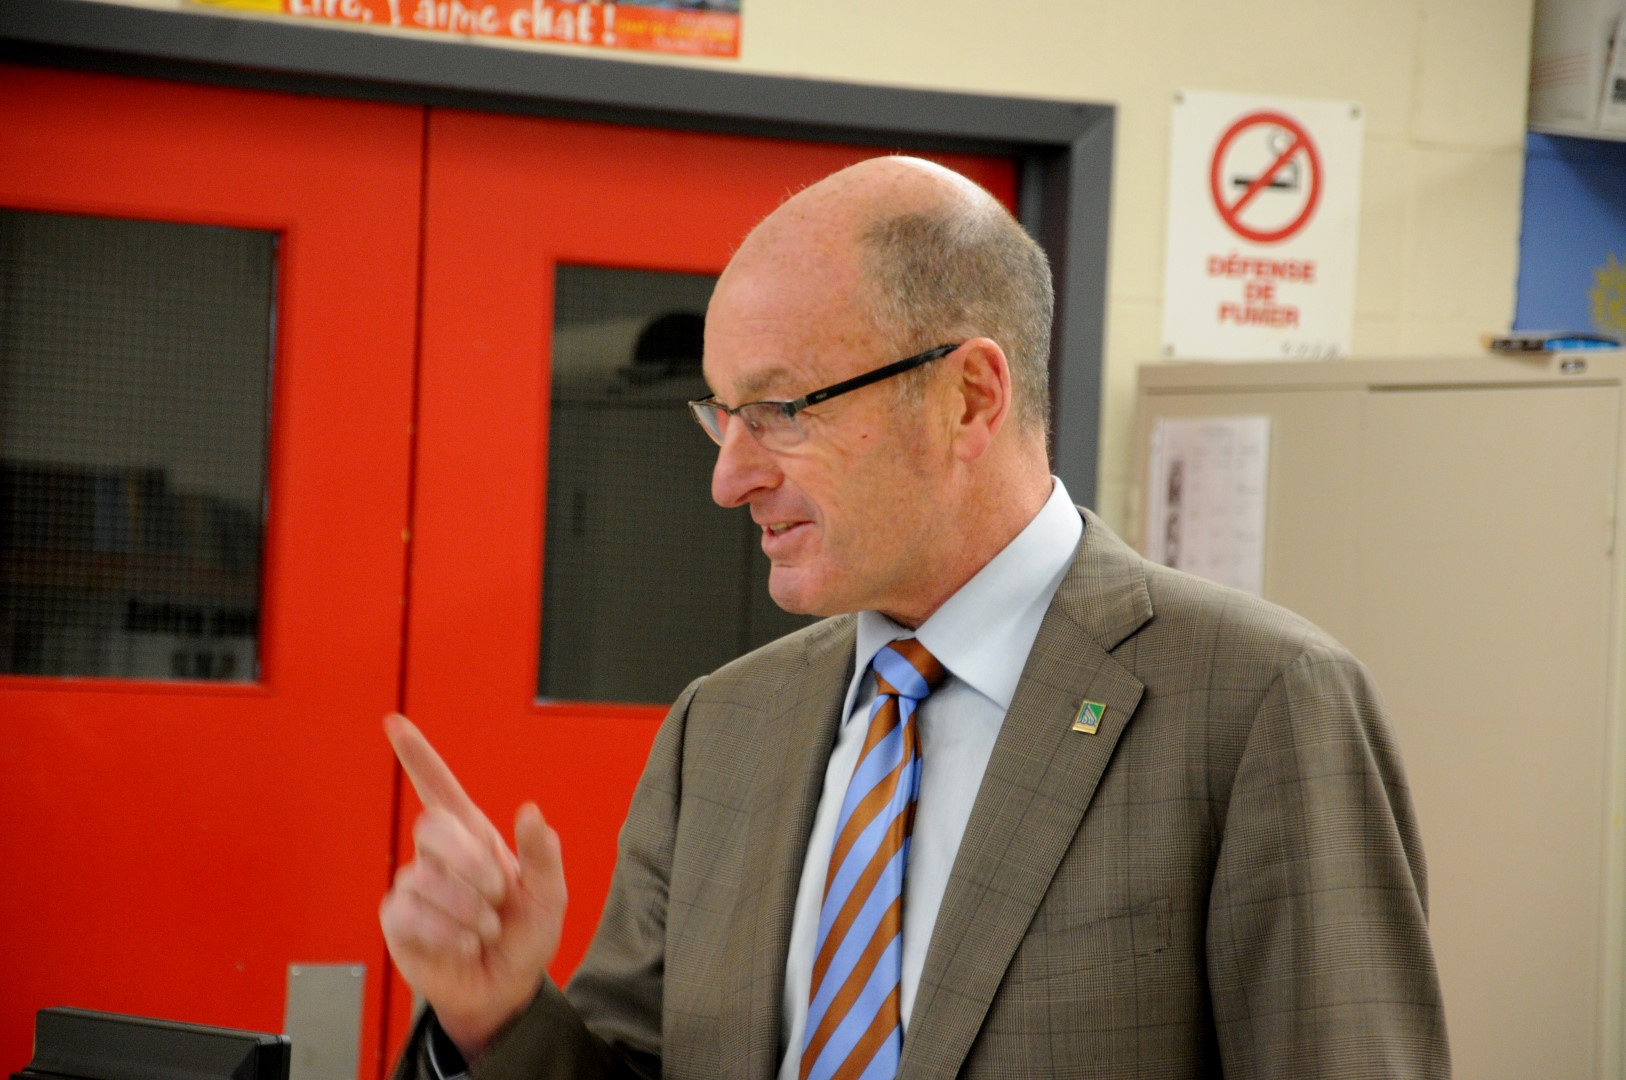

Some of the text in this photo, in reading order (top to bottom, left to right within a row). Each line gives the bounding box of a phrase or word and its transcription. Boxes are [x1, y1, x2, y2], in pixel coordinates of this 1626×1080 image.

[388, 0, 499, 33] jaime
[509, 0, 594, 43] chat
[1208, 252, 1314, 281] DÉFENSE
[1245, 283, 1274, 302] DE
[1219, 304, 1299, 328] FUMER
